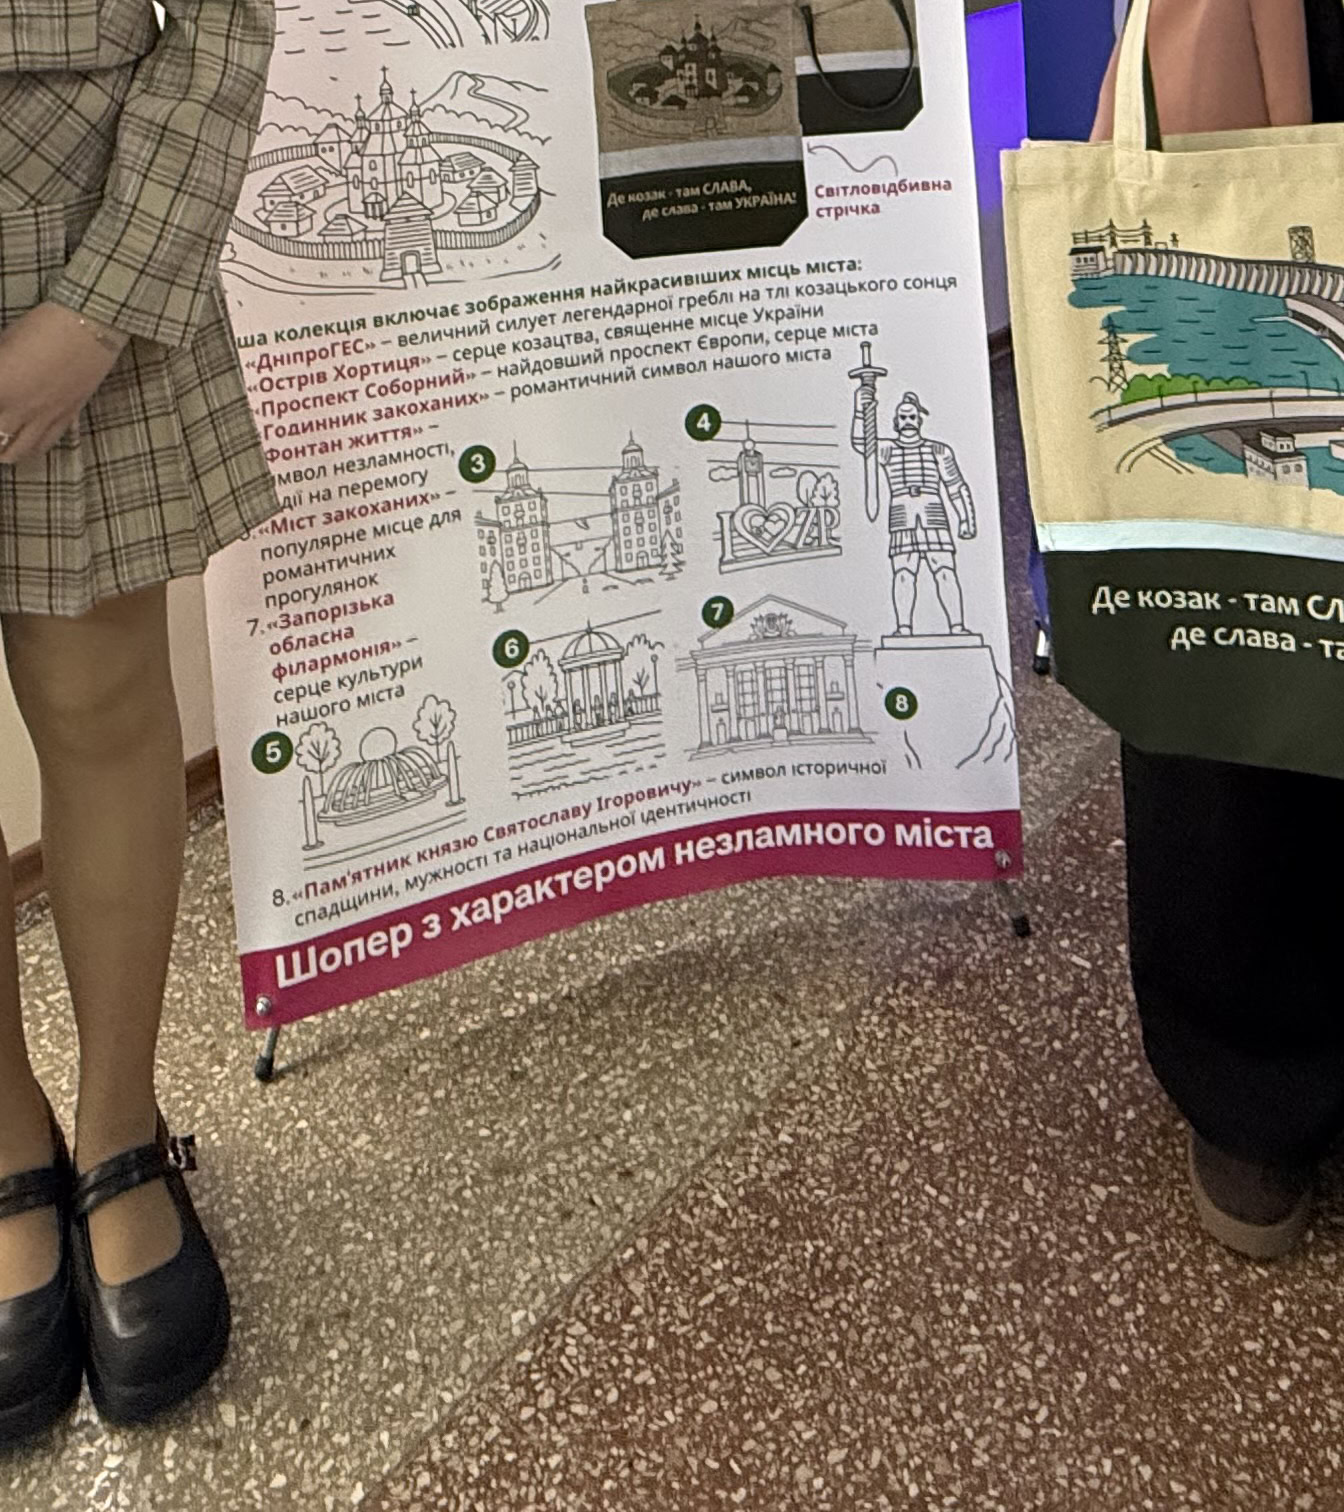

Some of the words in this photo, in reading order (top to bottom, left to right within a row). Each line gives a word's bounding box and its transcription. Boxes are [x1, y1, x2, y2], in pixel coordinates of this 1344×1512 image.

[676, 186, 700, 197] там
[709, 201, 732, 211] там
[815, 178, 952, 200] Світловідбивна
[816, 203, 880, 220] стрічка
[236, 333, 267, 348] ша
[274, 316, 367, 344] колекція
[373, 302, 460, 329] включає
[464, 287, 585, 315] зображення
[590, 269, 742, 299] найкрасивіших
[748, 262, 801, 282] місць
[806, 259, 862, 275] міста:
[398, 319, 491, 347] величний
[496, 312, 556, 334] силует
[562, 295, 674, 325] легендарної
[679, 286, 734, 313] греблі
[739, 290, 761, 302] на
[766, 286, 790, 301] тлі
[795, 277, 898, 298] козацького
[903, 274, 957, 291] сонця
[453, 341, 507, 366] серце
[604, 320, 695, 343] священне
[700, 311, 747, 330] місце
[754, 303, 823, 324] України
[497, 348, 604, 378] найдовший
[610, 340, 690, 362] проспект
[774, 326, 826, 344] серце
[833, 322, 878, 339] міста
[263, 410, 368, 441] Годинник
[510, 364, 636, 402] романтичний
[641, 360, 707, 379] символ
[713, 352, 780, 371] нашого
[786, 348, 832, 363] міста
[696, 412, 712, 432] 4
[265, 438, 343, 463] Фонтан
[272, 466, 327, 487] мвол
[333, 442, 455, 476] незламності,
[471, 454, 485, 473] 3
[280, 491, 303, 512] дії
[309, 489, 332, 503] на
[338, 468, 428, 499] перемогу
[260, 526, 366, 562] популярне
[373, 518, 424, 538] місце
[429, 509, 462, 530] для
[262, 546, 396, 588] романтичних
[265, 573, 379, 611] прогулянок
[1091, 585, 1131, 615] Де
[1138, 588, 1222, 610] козак
[1244, 593, 1300, 617] там
[711, 604, 723, 621] 7
[269, 626, 355, 656] обласна
[504, 638, 519, 659] 6
[1171, 627, 1207, 652] де
[1214, 626, 1297, 653] слава
[273, 678, 331, 704] серце
[337, 655, 423, 688] культури
[276, 699, 351, 728] нашого
[357, 684, 405, 707] міста
[894, 694, 909, 713] 8
[265, 740, 282, 763] 5
[416, 834, 478, 864] князю
[483, 801, 592, 842] Святославу
[722, 764, 786, 785] символ
[791, 760, 887, 777] історичної
[295, 883, 400, 927] спадщини,
[404, 855, 489, 892] мужності
[494, 851, 513, 865] та
[517, 813, 636, 856] національної
[640, 789, 752, 825] ідентичності
[275, 921, 414, 989] Шопер
[422, 913, 442, 940] з
[450, 847, 665, 931] характером
[674, 818, 886, 866] незламного
[894, 816, 994, 849] міста
